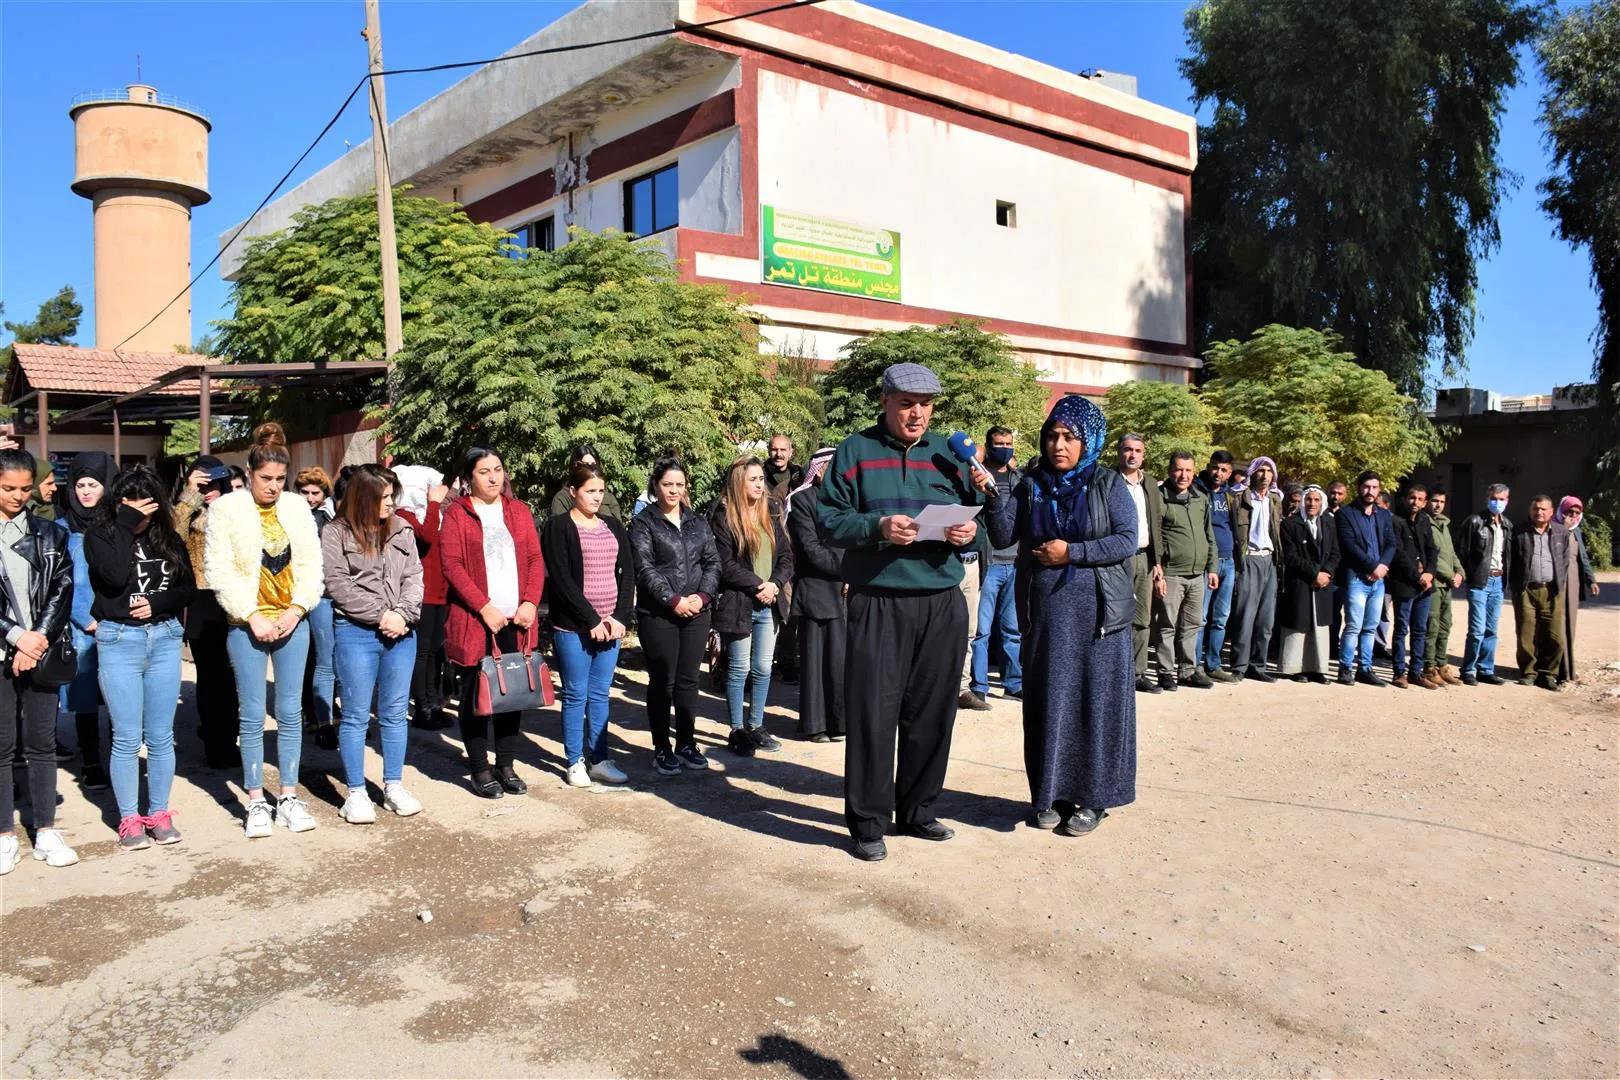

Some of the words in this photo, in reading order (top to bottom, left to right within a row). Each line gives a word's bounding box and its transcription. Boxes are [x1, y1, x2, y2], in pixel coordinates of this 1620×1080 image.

[765, 261, 796, 281] تمر
[798, 263, 820, 285] تل
[823, 265, 863, 289] منطقة
[865, 280, 899, 297] مجلس
